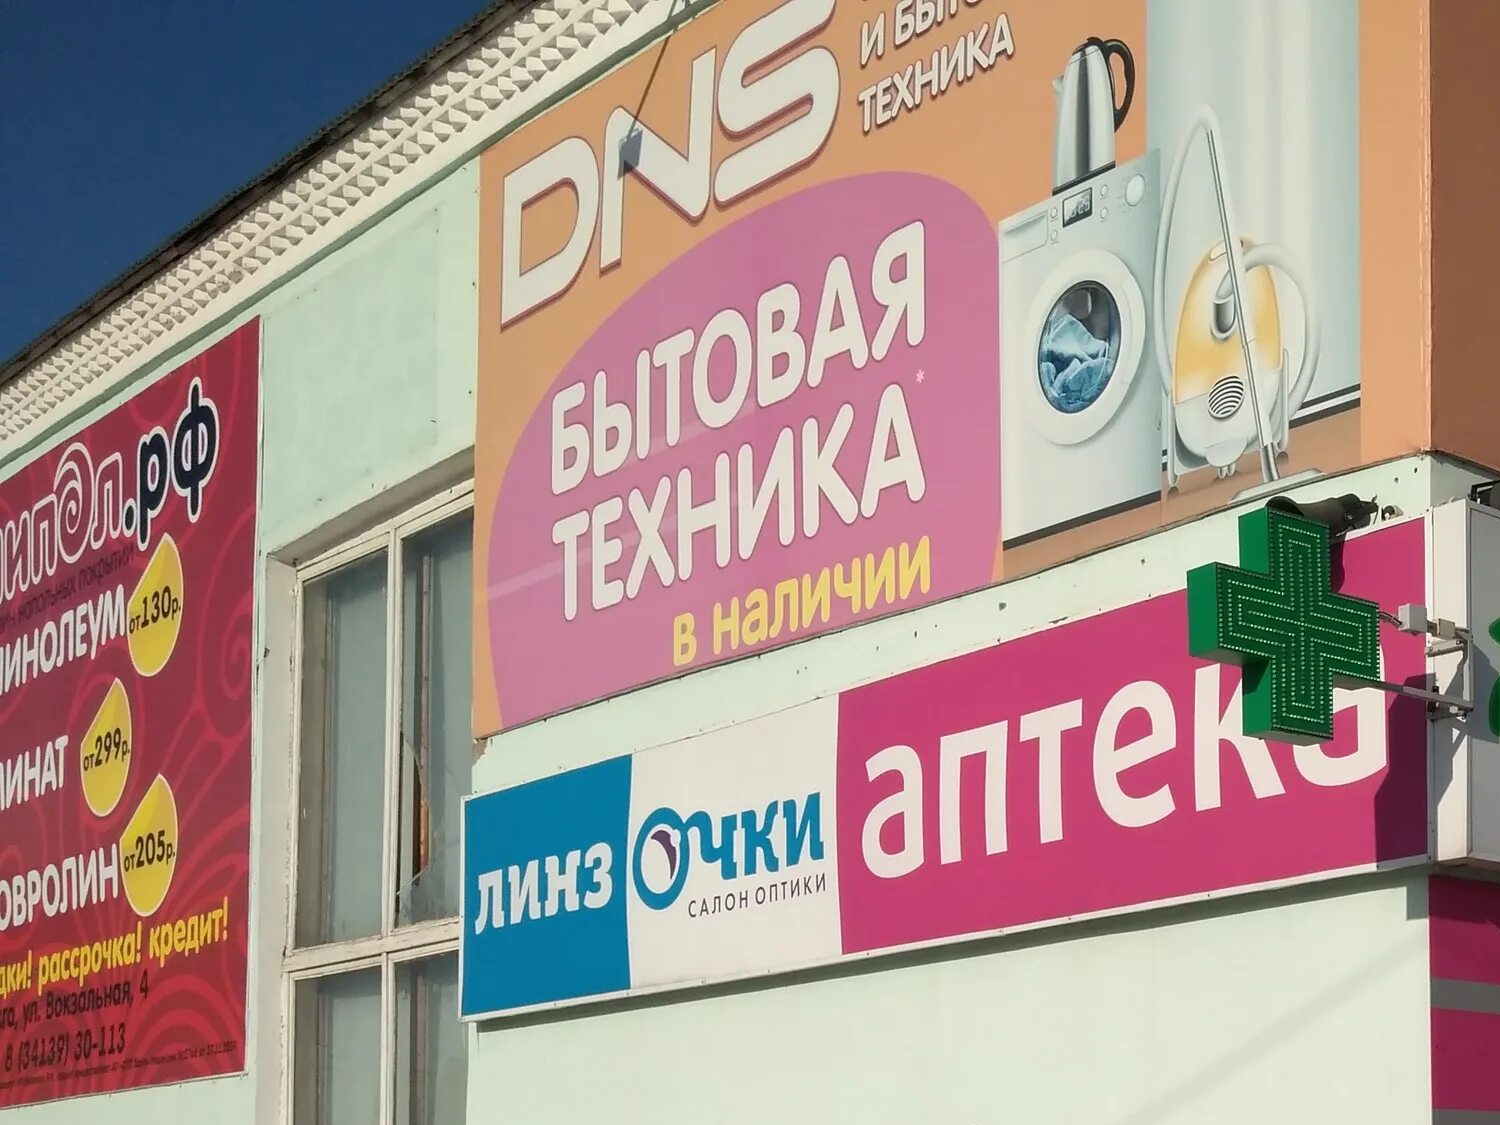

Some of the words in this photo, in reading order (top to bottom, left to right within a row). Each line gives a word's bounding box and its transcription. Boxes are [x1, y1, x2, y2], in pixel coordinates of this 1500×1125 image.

[858, 13, 1015, 133] ТЕХНИКА
[860, 11, 886, 67] И
[499, 0, 842, 328] DNS
[548, 219, 927, 496] БЫТОВАЯ
[552, 383, 927, 621] ТЕХНИКА
[673, 612, 698, 666] в
[713, 535, 931, 656] наличии
[0, 735, 69, 811] ИНАТ
[688, 890, 748, 917] САЛОН
[755, 874, 826, 905] ОПТИКИ
[38, 921, 142, 996] рассрочка!
[150, 896, 228, 968] кредит!
[46, 979, 134, 1020] Вокзальная,
[140, 969, 149, 999] 4
[5, 1044, 13, 1072] 8
[18, 1034, 70, 1071] (34139)
[75, 1022, 125, 1060] 30-113
